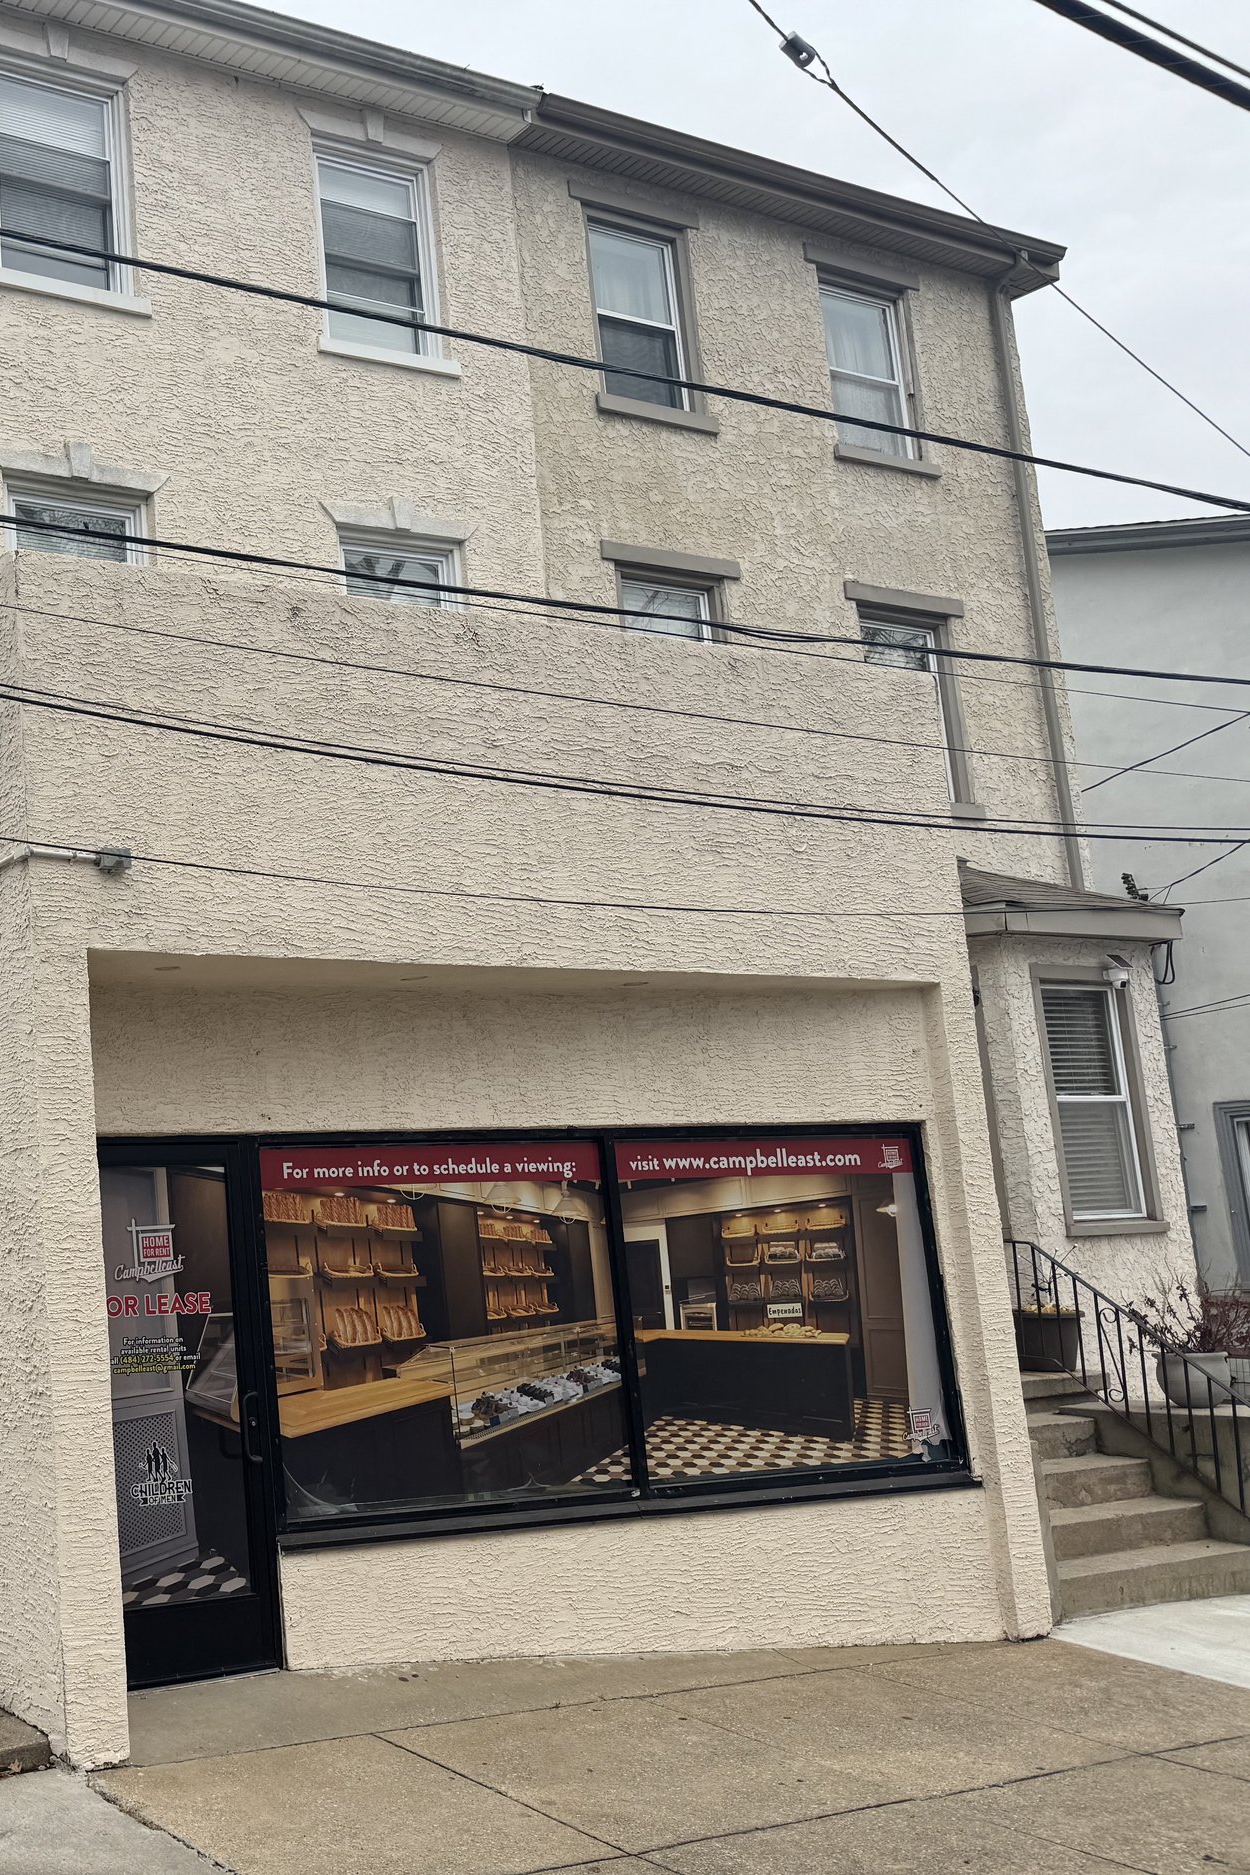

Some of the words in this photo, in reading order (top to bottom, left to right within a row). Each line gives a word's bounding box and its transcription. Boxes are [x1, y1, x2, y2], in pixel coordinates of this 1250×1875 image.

[629, 1155, 660, 1171] visit
[662, 1148, 861, 1175] www.campbelleast.com
[282, 1162, 309, 1179] For
[313, 1167, 354, 1179] more
[357, 1160, 389, 1177] info
[393, 1166, 409, 1177] or
[413, 1162, 430, 1176] to
[433, 1158, 500, 1176] schedule
[503, 1163, 512, 1174] a
[515, 1157, 577, 1179] viewing:
[143, 1236, 170, 1247] HOME
[143, 1248, 155, 1257] FOR
[155, 1247, 170, 1256] RENT
[114, 1254, 186, 1282] Campbelleast
[106, 1295, 140, 1318] OR
[144, 1292, 212, 1317] LEASE
[123, 1337, 135, 1346] For
[135, 1336, 174, 1345] information
[121, 1346, 149, 1355] available
[150, 1345, 169, 1353] rental
[111, 1357, 119, 1365] all
[120, 1355, 140, 1365] (484)
[183, 1353, 201, 1361] email
[113, 1363, 196, 1375] campbelleast@gmail.com
[131, 1479, 193, 1498] CHILDREN
[149, 1496, 159, 1505] OF
[160, 1495, 176, 1503] MEN
